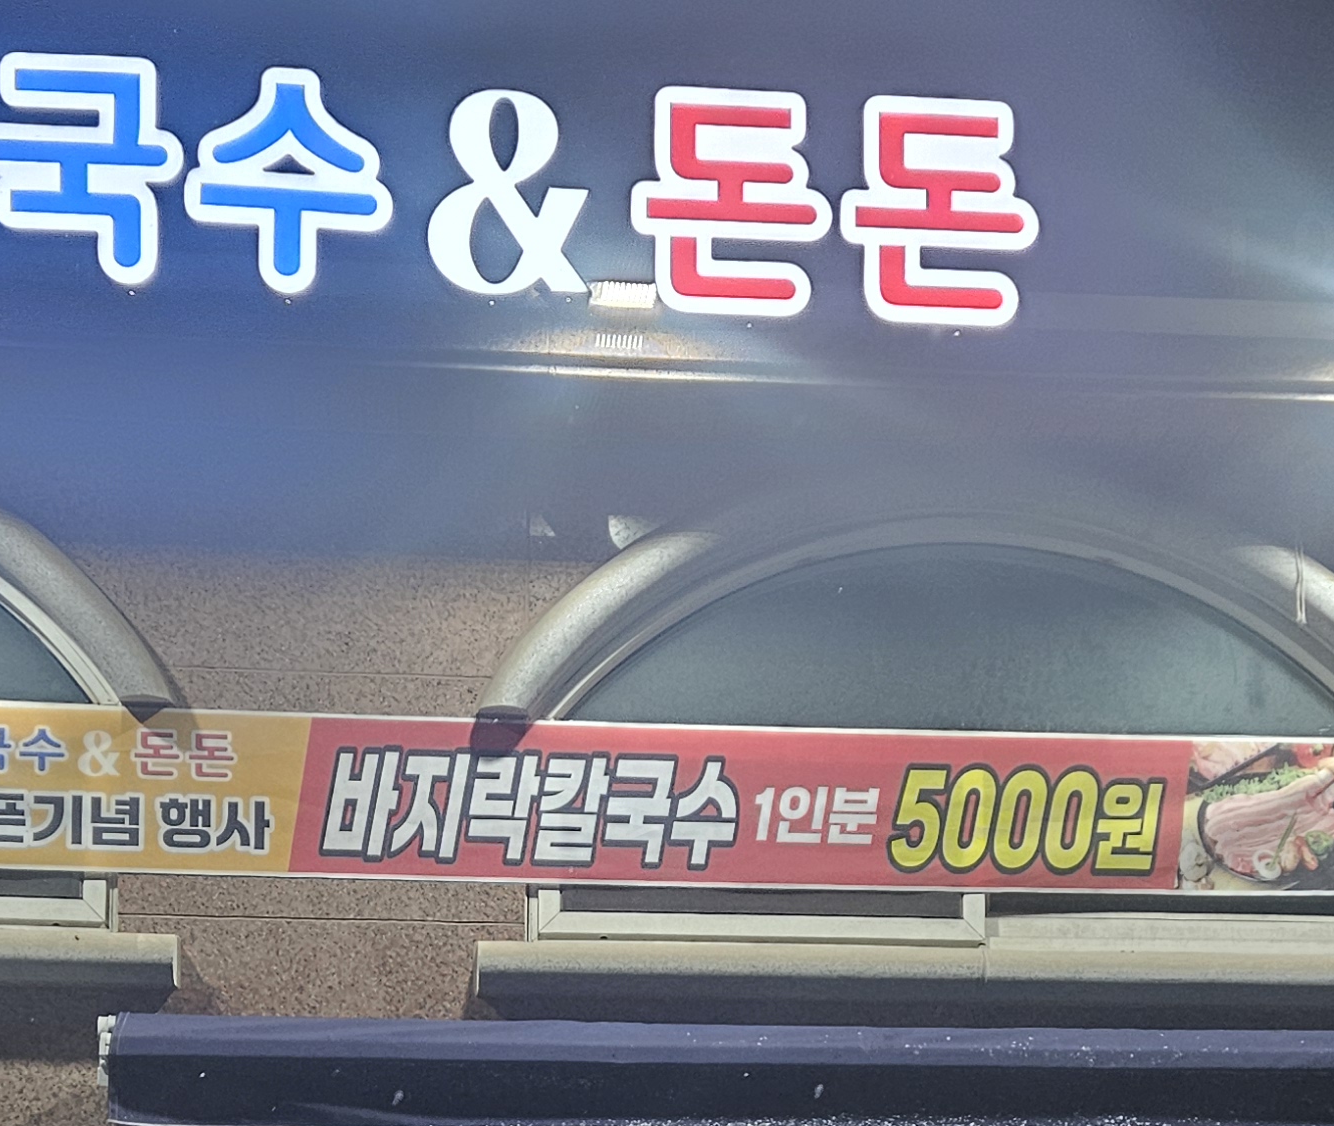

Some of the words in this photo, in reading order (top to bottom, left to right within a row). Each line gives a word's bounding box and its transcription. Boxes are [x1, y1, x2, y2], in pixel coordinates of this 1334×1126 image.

[427, 87, 592, 295] &
[634, 84, 1043, 330] 돈돈
[77, 730, 121, 780] &
[130, 726, 240, 783] 돈돈
[156, 795, 273, 855] 행사
[319, 743, 741, 873] 바지락칼국수
[753, 782, 877, 850] 1인분
[886, 763, 1167, 878] 5000원
